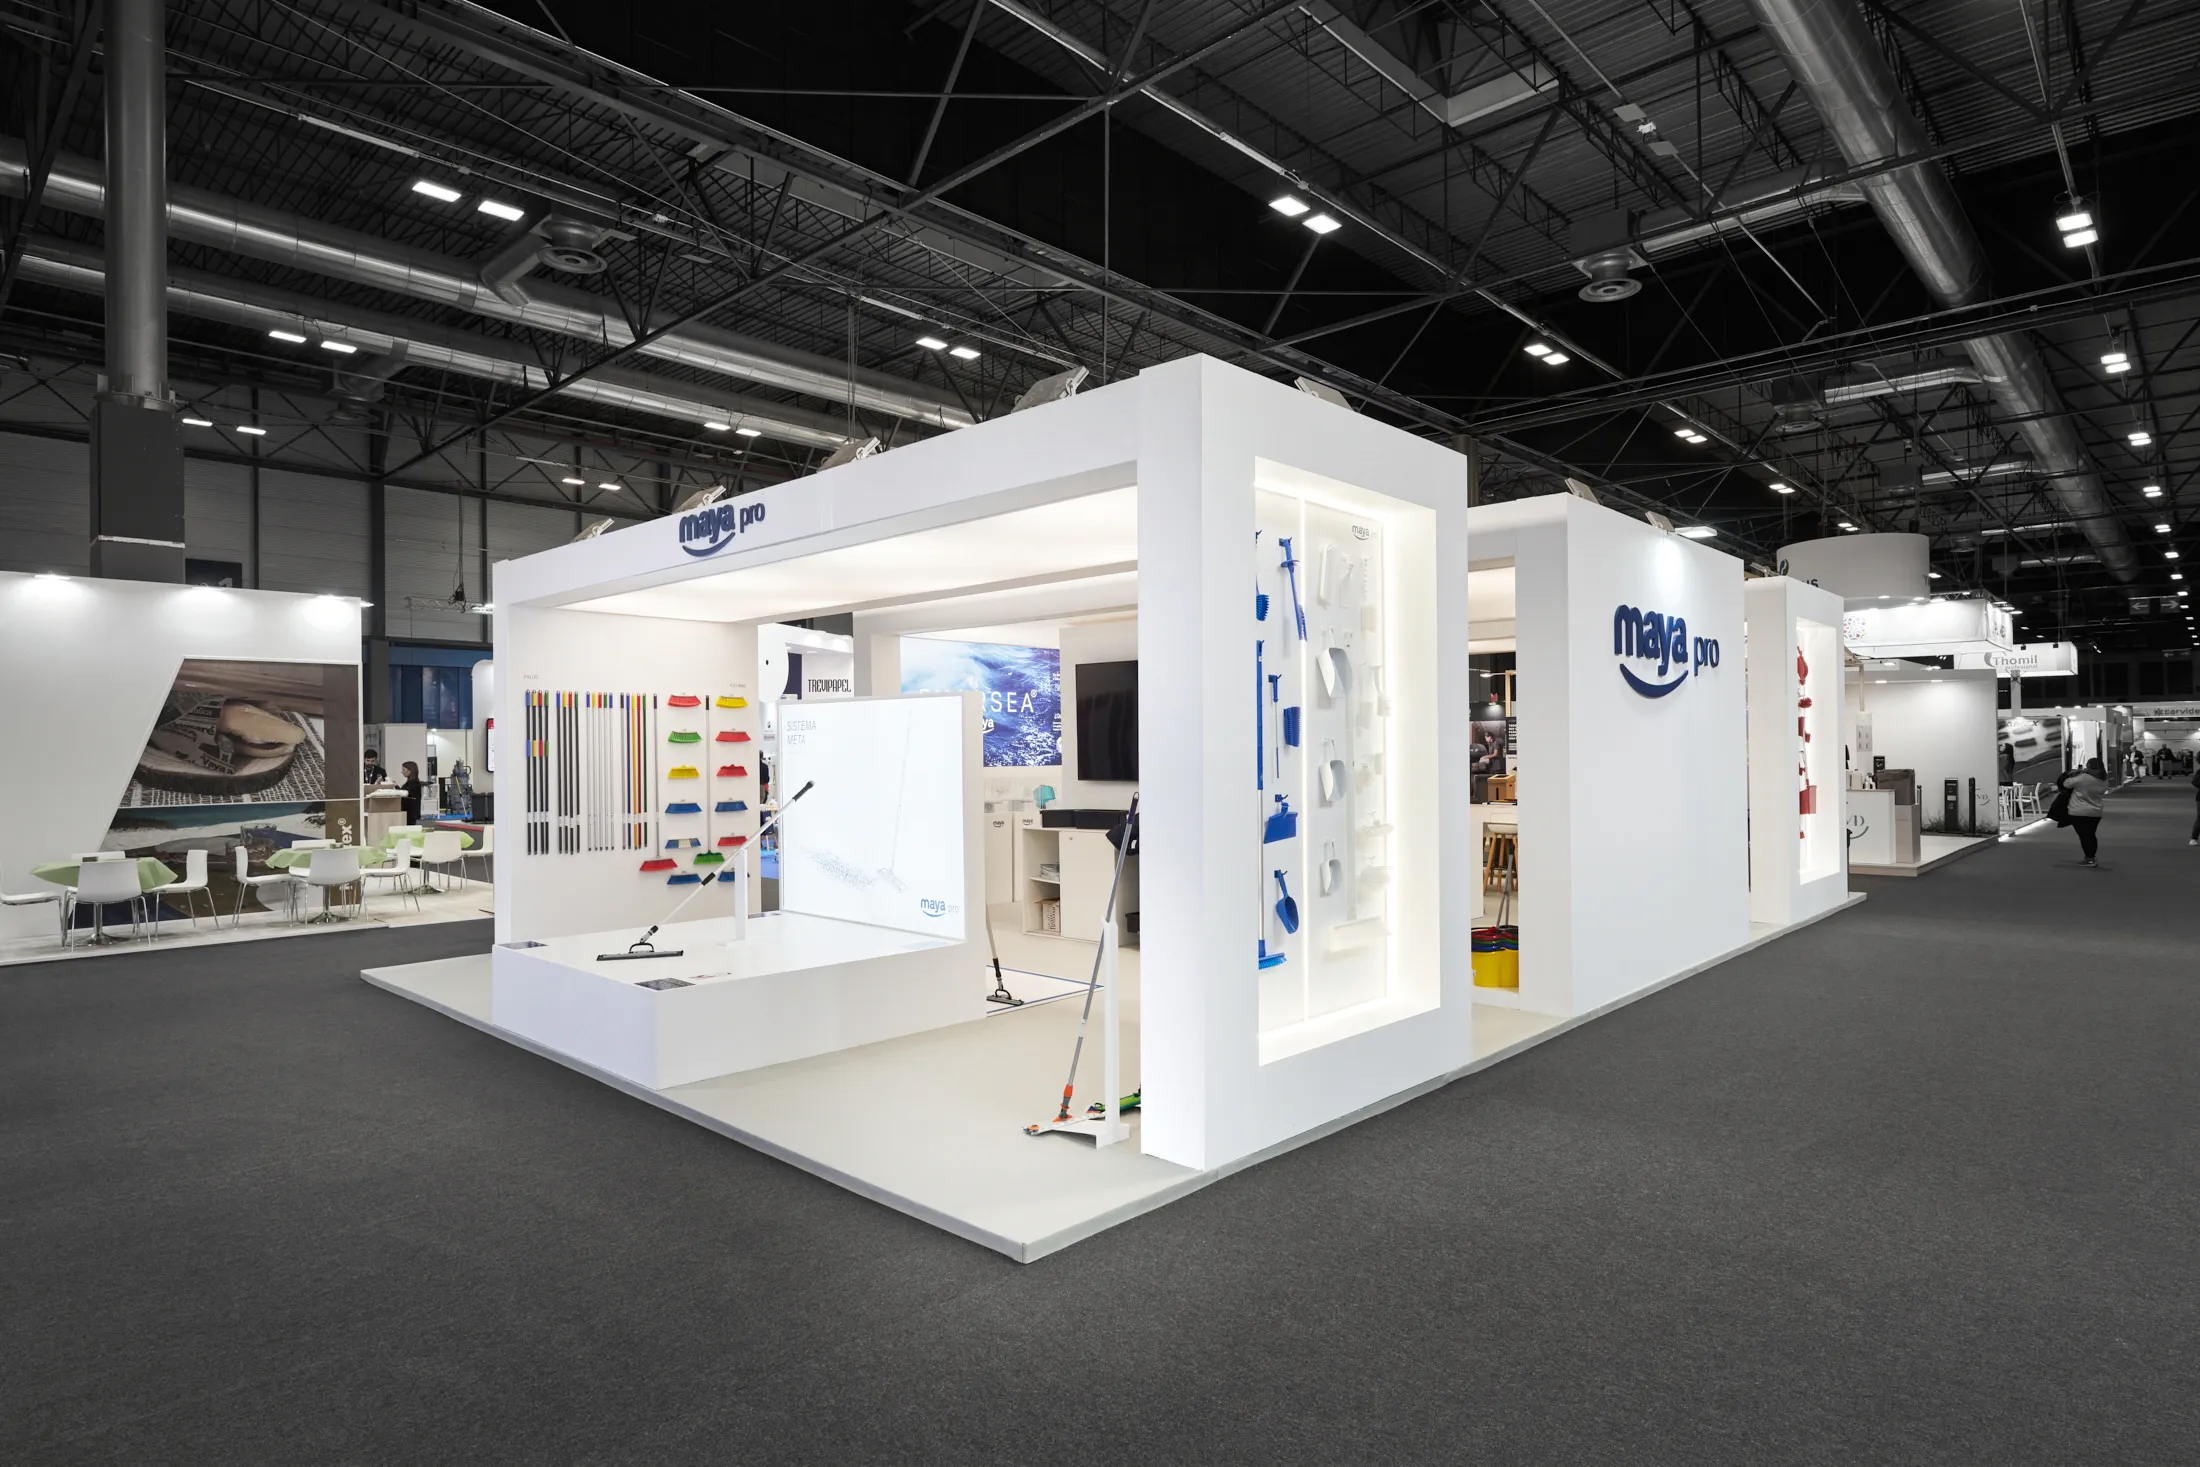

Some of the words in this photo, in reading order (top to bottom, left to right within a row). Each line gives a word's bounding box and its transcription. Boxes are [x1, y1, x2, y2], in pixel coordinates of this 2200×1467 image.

[679, 504, 736, 543] maya
[740, 503, 765, 533] pro
[1352, 525, 1369, 537] maya
[1614, 605, 1688, 677] maya
[1694, 637, 1719, 677] pro
[1992, 654, 2038, 666] Thomil
[808, 679, 851, 692] TREVIPAPEL
[787, 720, 816, 731] SISTEMA
[787, 734, 806, 745] META
[920, 898, 946, 913] maya
